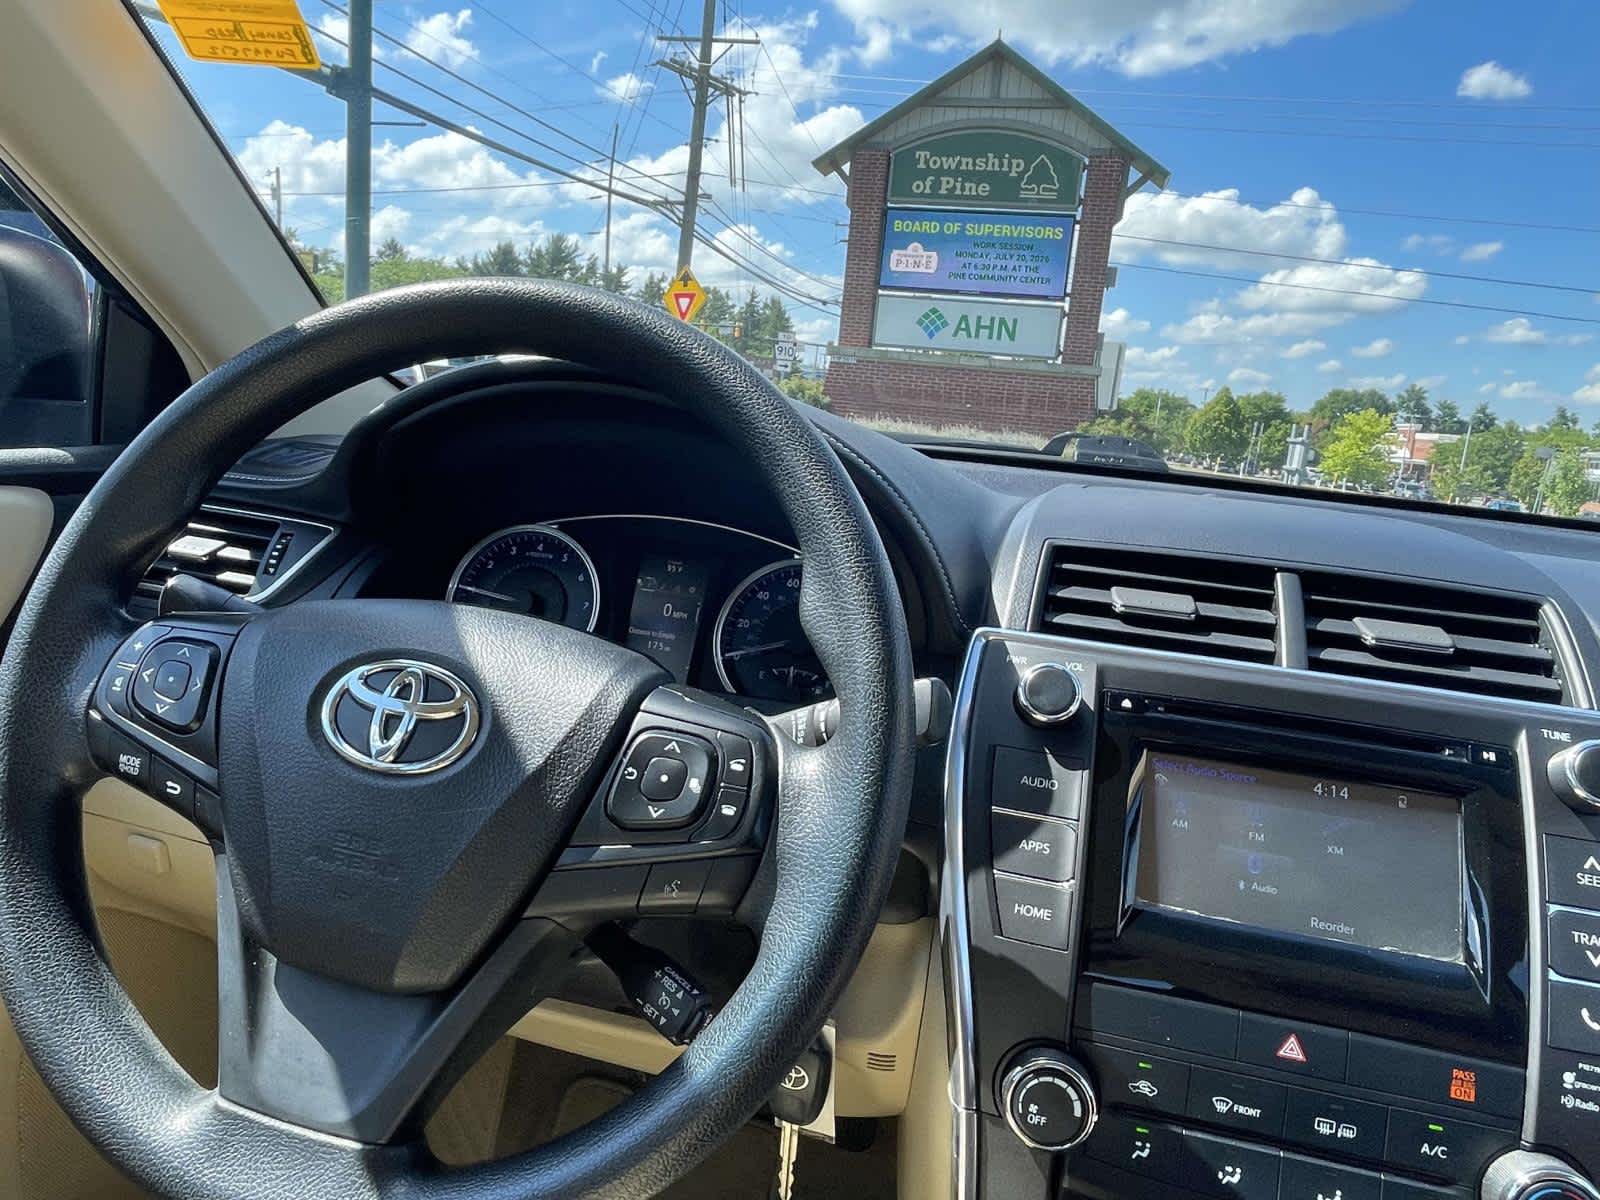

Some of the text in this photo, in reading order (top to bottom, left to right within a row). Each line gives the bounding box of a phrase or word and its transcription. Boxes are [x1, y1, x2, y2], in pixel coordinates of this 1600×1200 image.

[915, 151, 1025, 177] Township
[911, 176, 991, 197] of Pine
[893, 220, 1064, 240] BOARD OF SUPERVISORS
[973, 240, 1035, 252] WORK SESSION
[993, 252, 1013, 263] JULY
[961, 261, 973, 271] AT
[1012, 264, 1024, 275] AT
[1025, 265, 1041, 275] THE
[948, 271, 1053, 286] PINE COMMUNITY CENTER
[951, 313, 1019, 343] AHN
[777, 346, 794, 357] 910
[510, 546, 517, 555] 3
[487, 560, 494, 569] 2
[578, 574, 584, 582] 6
[786, 578, 800, 588] 60
[757, 591, 769, 600] 40
[663, 603, 672, 617] 0
[737, 618, 750, 628] 20
[1064, 660, 1086, 672] VOL
[1540, 728, 1573, 743] TUNE
[119, 753, 142, 768] MODE
[1020, 775, 1060, 791] AUDIO
[1313, 781, 1350, 800] 4:14
[1171, 817, 1190, 830] AM
[1248, 830, 1266, 843] FM
[1018, 839, 1052, 855] APPS
[1326, 844, 1345, 857] XM
[1251, 881, 1279, 896] Audio
[1013, 902, 1054, 922] HOME
[1310, 916, 1356, 936] Reorder
[661, 976, 678, 992] RES
[664, 966, 692, 991] CANCEL
[643, 1003, 660, 1019] SET
[1452, 1068, 1476, 1082] PASS
[1454, 1087, 1474, 1100] ON
[1233, 1103, 1262, 1118] FRONT
[1575, 1098, 1600, 1112] Radio
[1027, 1114, 1048, 1127] OFF
[1420, 1142, 1448, 1158] A/C
